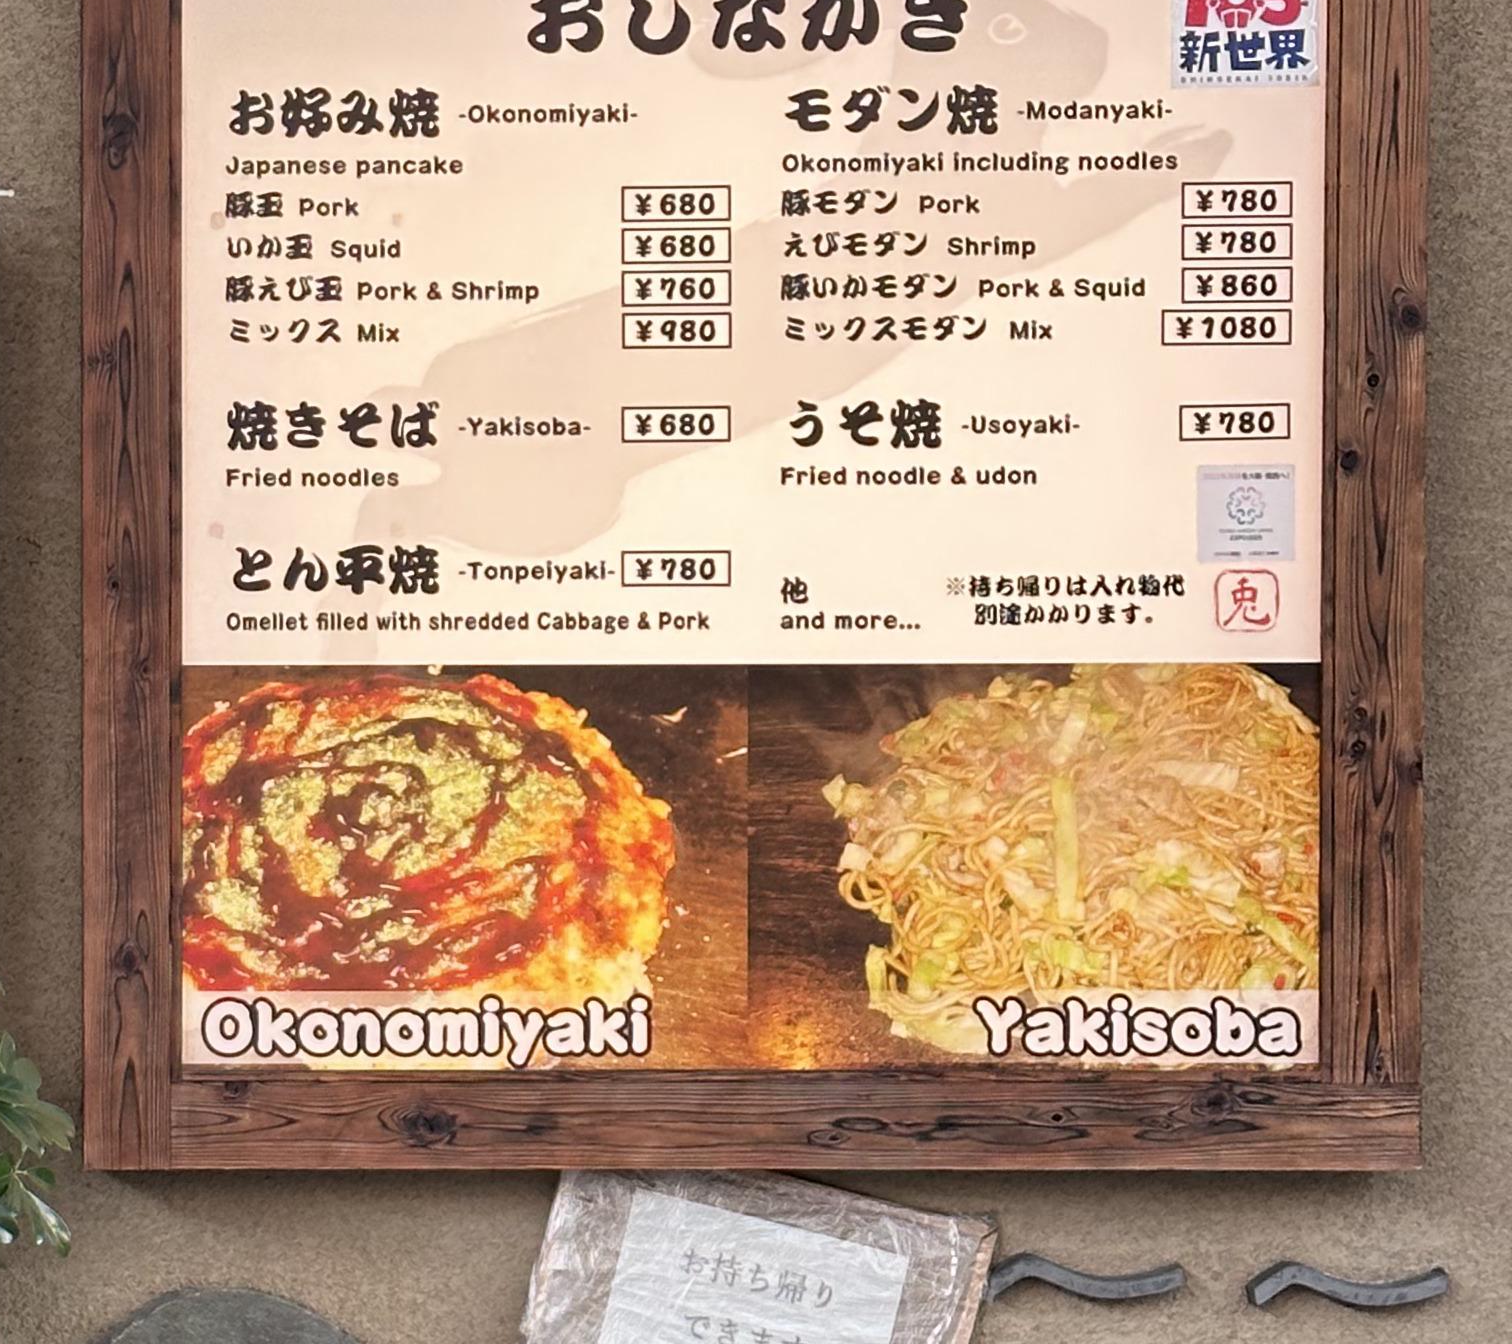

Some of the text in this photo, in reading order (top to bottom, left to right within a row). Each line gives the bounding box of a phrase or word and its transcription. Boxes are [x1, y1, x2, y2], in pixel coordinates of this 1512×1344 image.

[1179, 29, 1310, 72] 新世界
[228, 87, 638, 139] お好み焼 -Okonomiyaki-
[784, 83, 1172, 136] モダン焼 -Modanyaki-
[225, 156, 463, 179] Japanese pancake
[782, 151, 1178, 177] Okonomiyaki including noodles
[225, 190, 359, 219] 豚玉 Pork
[635, 192, 715, 217] ¥680
[781, 188, 980, 217] 豚モダン Pork
[1196, 189, 1277, 213] ¥780
[227, 233, 401, 263] いか玉 Squid
[635, 234, 716, 258] ¥680
[784, 231, 1036, 260] えびモダン Shrimp
[1195, 230, 1277, 254] ¥780
[225, 274, 539, 305] 豚えび玉 Pork & Shrimp
[635, 277, 716, 301] ¥760
[780, 273, 1146, 302] 豚いかモダン Pork & Squid
[1195, 273, 1278, 298] ¥860
[229, 318, 400, 344] ミックス Mix
[636, 319, 716, 343] ¥980
[785, 315, 1052, 342] ミックスモダン Mix
[1176, 316, 1277, 339] ¥1080
[226, 400, 591, 451] 焼きそば -Yakisoba-
[635, 413, 715, 437] ¥680
[789, 398, 1080, 449] うそ焼 -Usoyaki-
[1193, 410, 1275, 435] ¥780
[226, 467, 399, 487] Fried noodles
[780, 465, 1037, 486] Fried noodle & udon
[232, 544, 615, 595] とん平焼 -Tonpeiyaki-
[635, 557, 716, 581] ¥780
[780, 576, 809, 605] 他
[226, 611, 710, 635] Omellet filled with shredded Cabbage & Pork
[780, 611, 921, 630] and more...
[200, 995, 653, 1068] Okonomiyaki
[974, 996, 1302, 1058] Yakisoba
[682, 1249, 833, 1309] お持ち帰り
